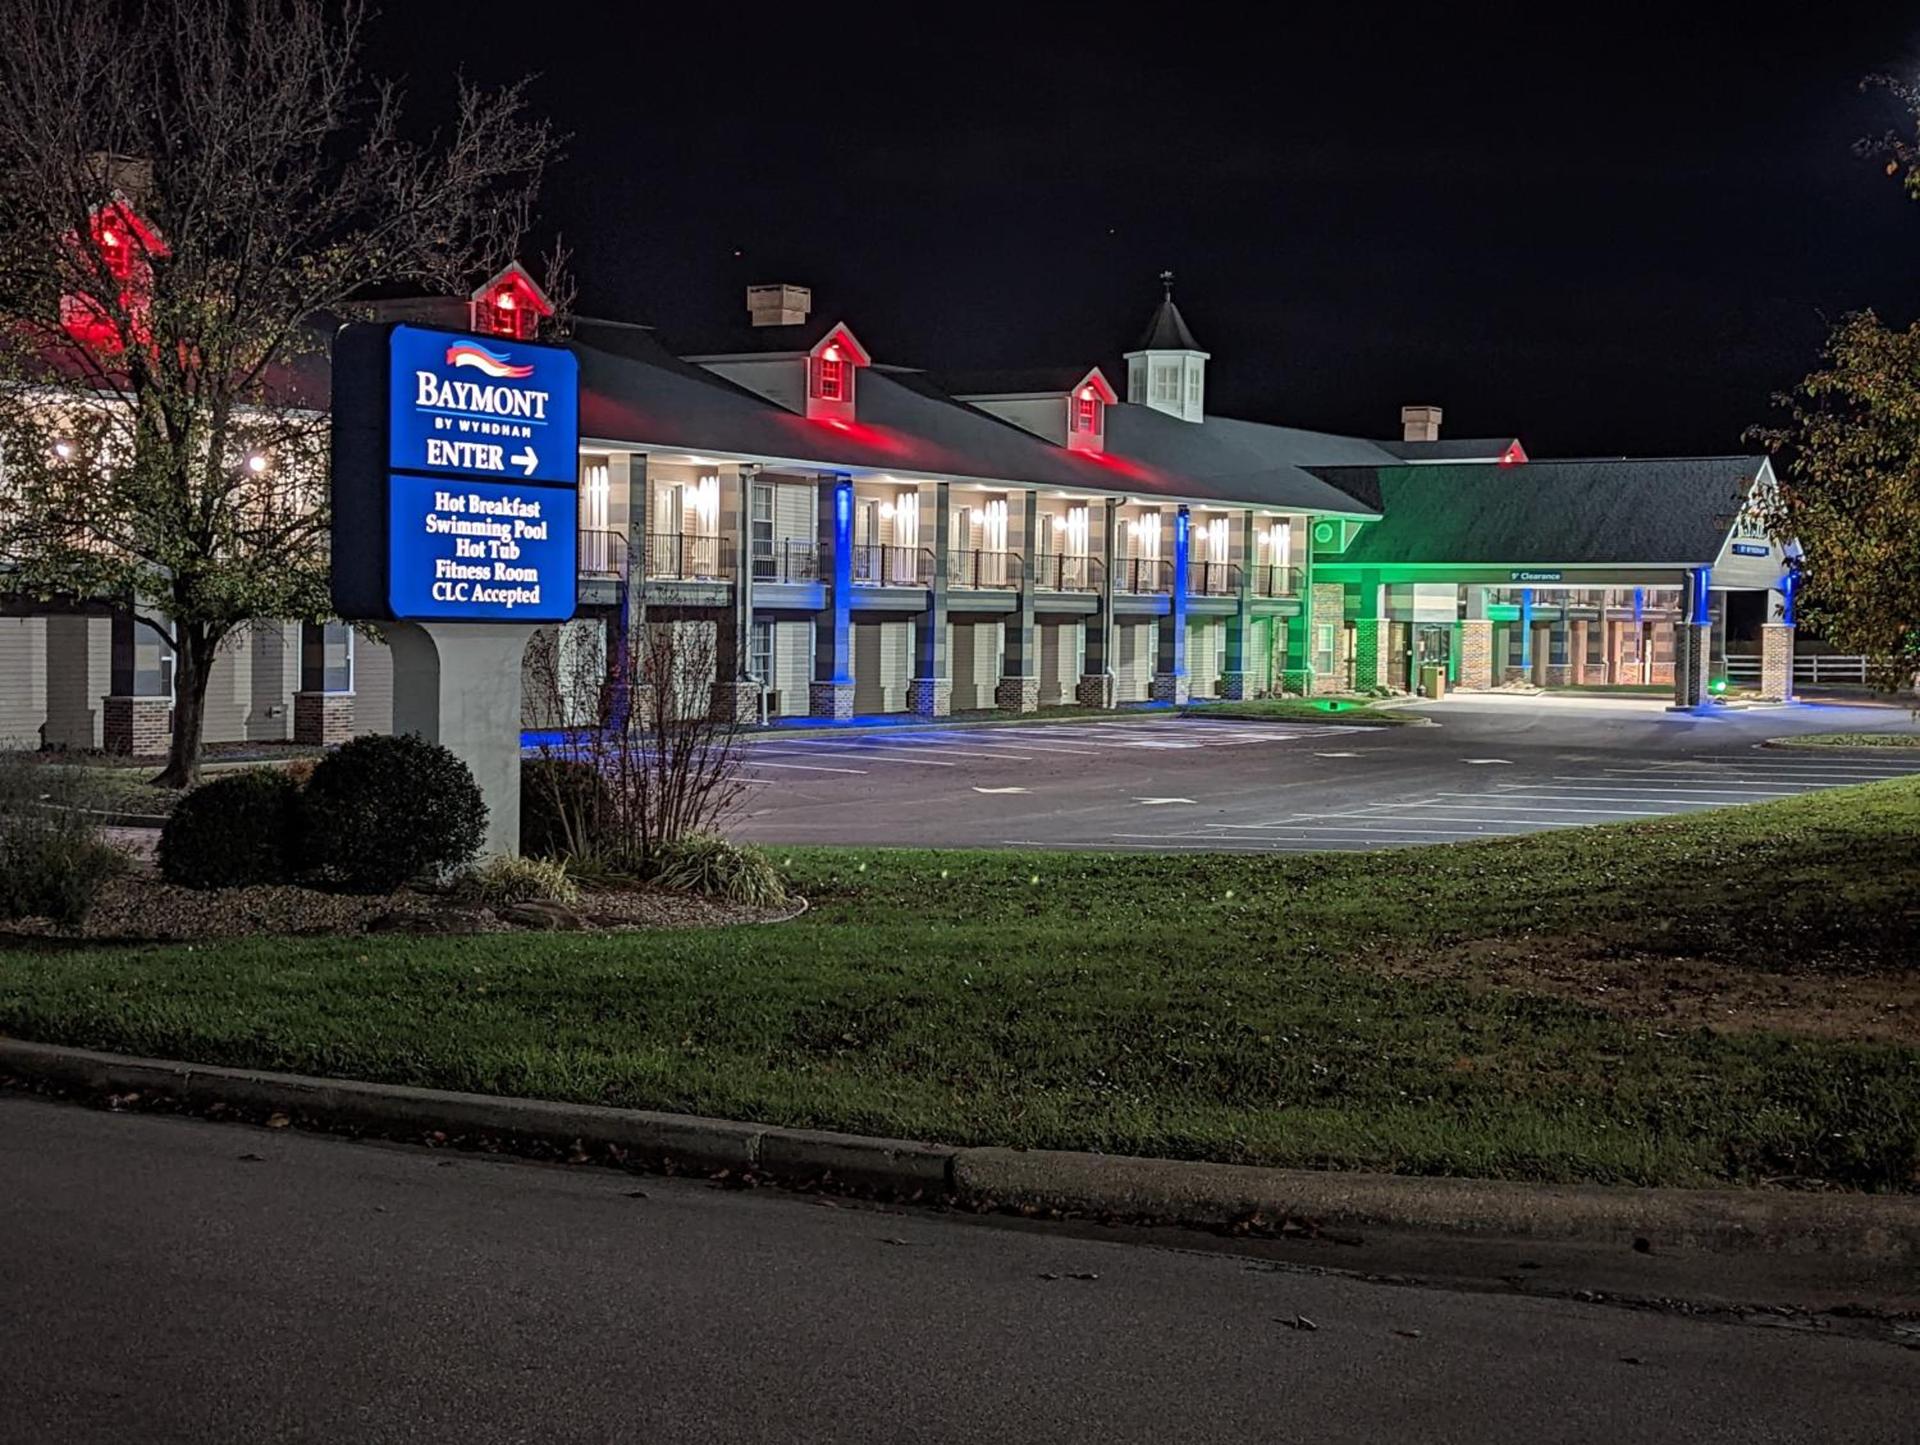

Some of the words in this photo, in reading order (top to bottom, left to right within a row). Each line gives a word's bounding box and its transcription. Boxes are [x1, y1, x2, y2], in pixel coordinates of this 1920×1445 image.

[416, 371, 549, 419] BAYMONT
[434, 417, 453, 430] BY
[459, 420, 531, 438] WYNDHAM
[427, 438, 504, 471] ENTER
[435, 492, 466, 514] Hot
[468, 494, 541, 518] Breakfast
[425, 514, 512, 543] Swimming
[514, 521, 547, 541] Pool
[456, 539, 486, 559] Hot
[488, 541, 520, 560] Tub
[435, 560, 491, 581] Fitness
[494, 564, 538, 582] Room
[1520, 572, 1561, 580] Clearance
[432, 583, 471, 603] CLC
[473, 584, 540, 609] Accepted
